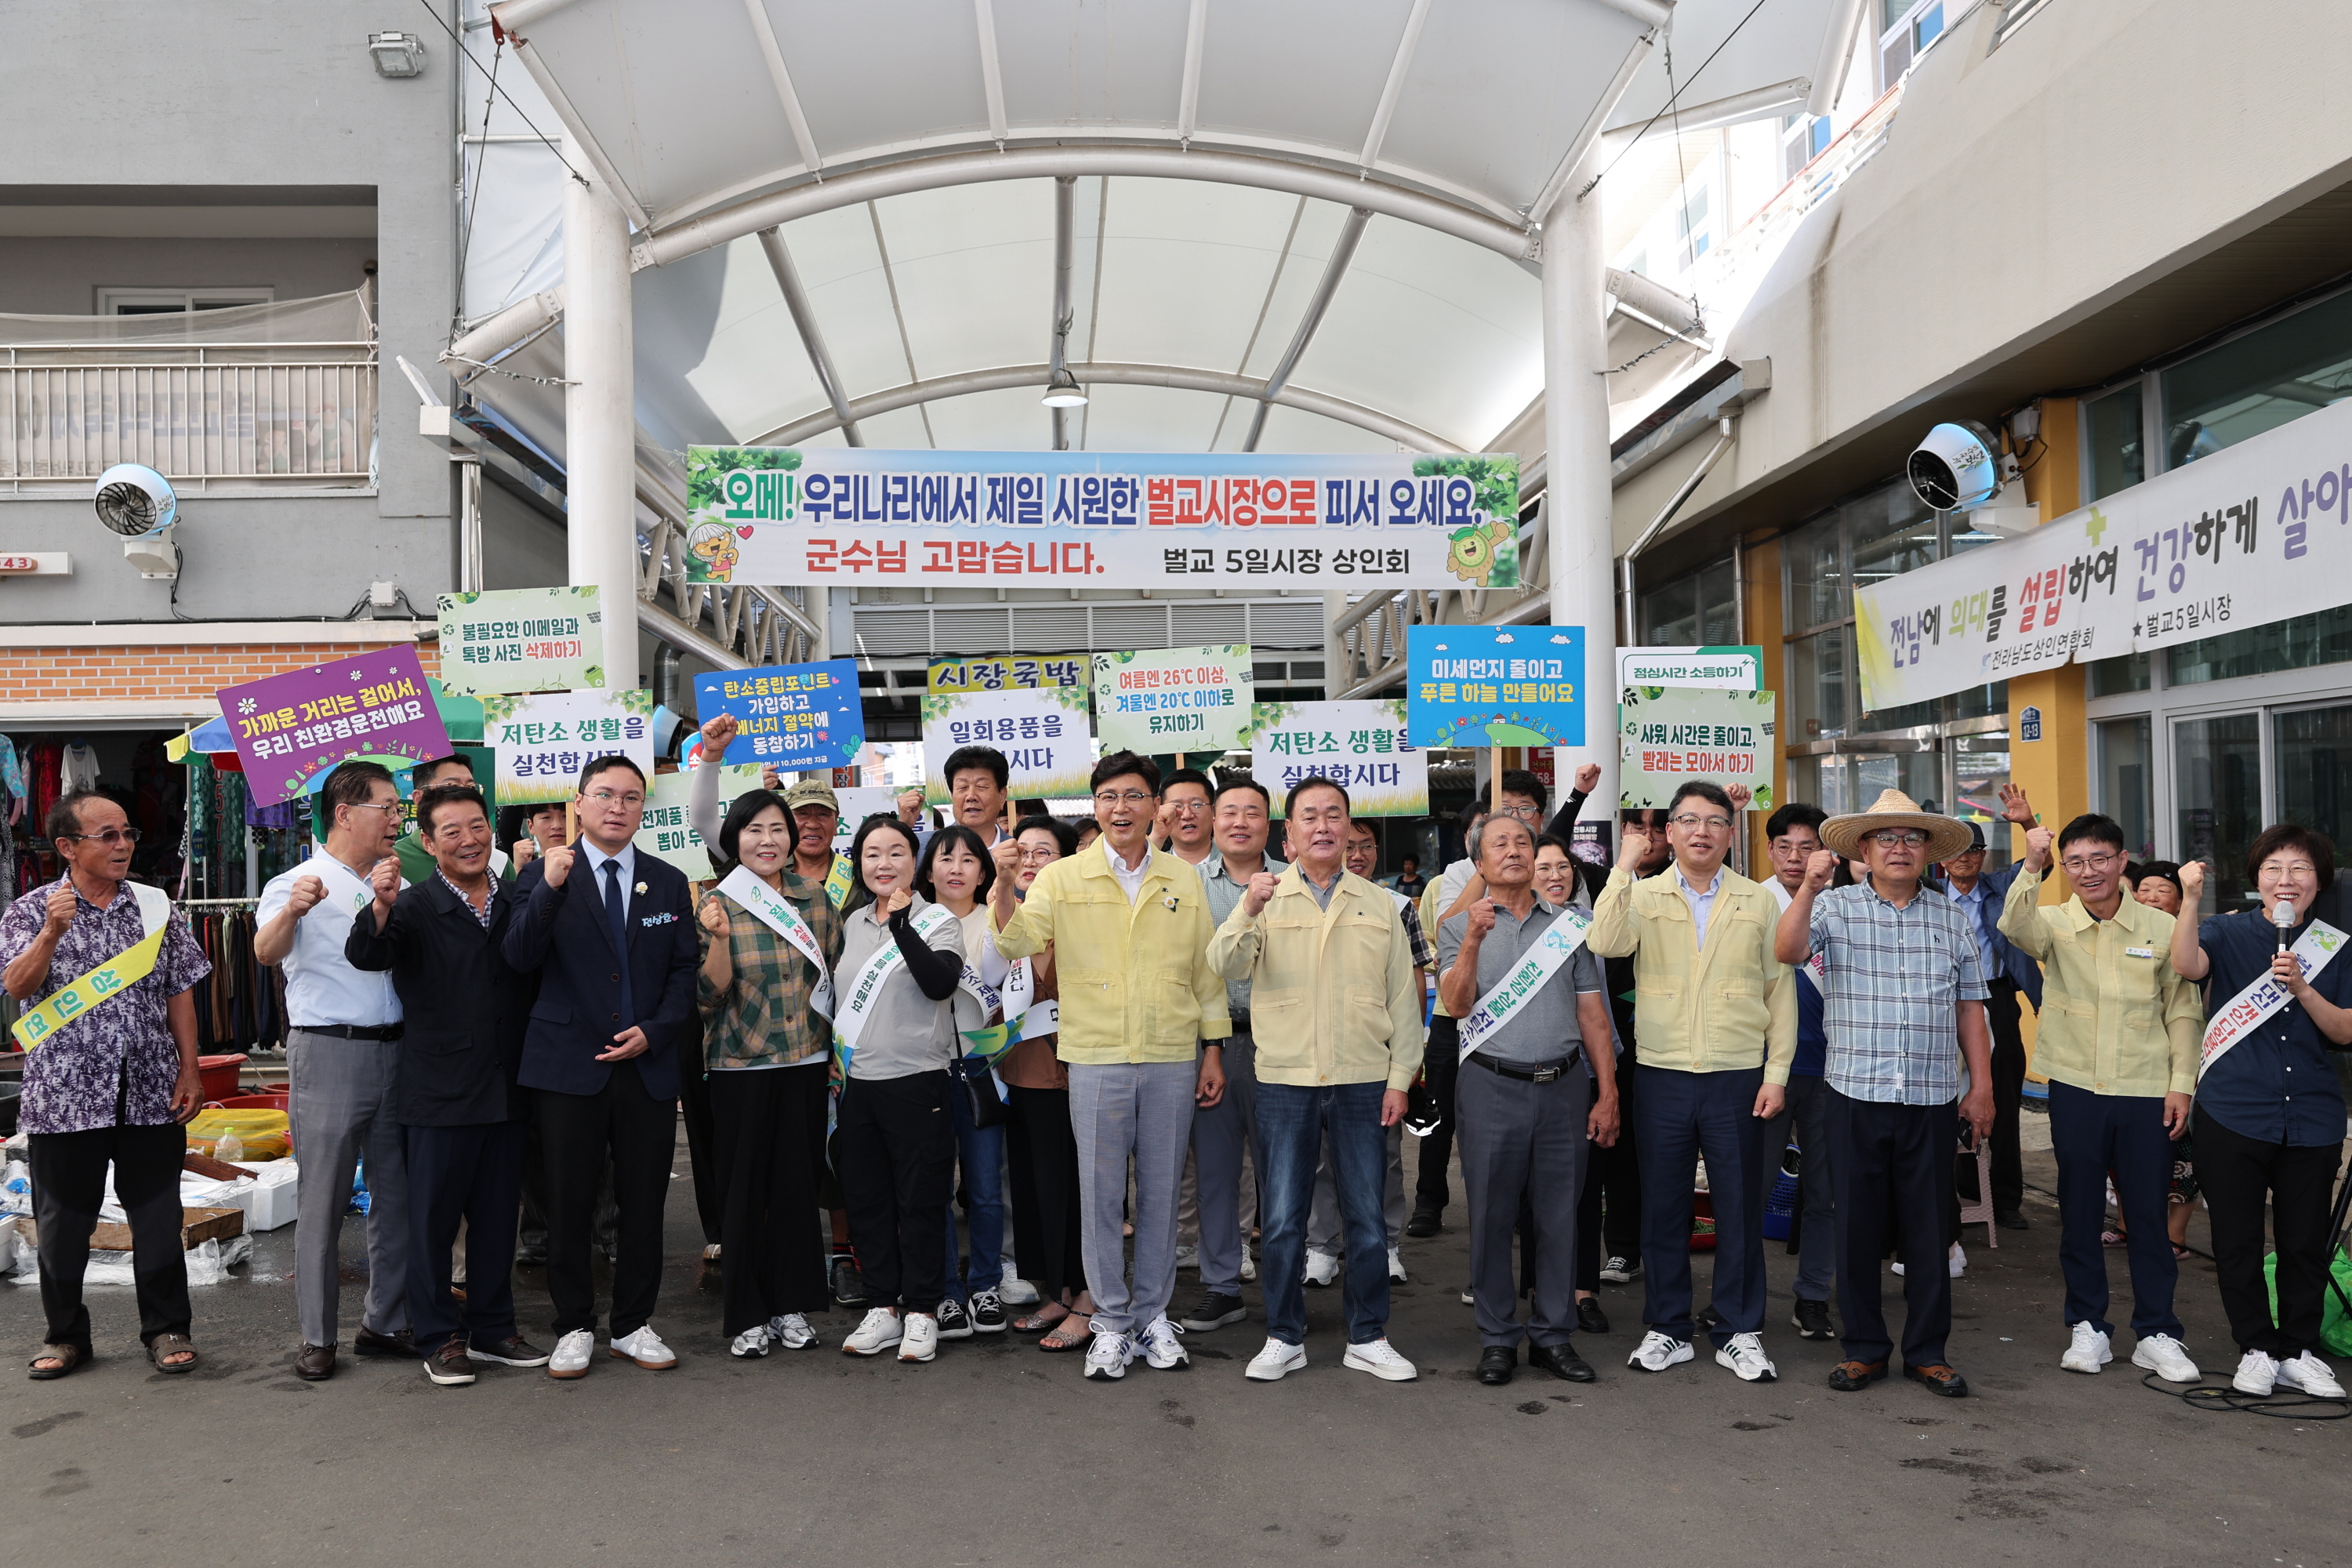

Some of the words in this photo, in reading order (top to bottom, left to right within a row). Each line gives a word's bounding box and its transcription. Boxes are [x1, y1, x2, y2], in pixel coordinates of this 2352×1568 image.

[725, 474, 794, 521] 오메!
[803, 474, 977, 523] 우리나라에서
[986, 476, 1044, 524] 제일
[1052, 477, 1139, 525] 시원한
[1147, 478, 1317, 526] 벌교시장으로
[1326, 479, 1380, 526] 피서
[1388, 479, 1482, 526] 오세요.
[806, 539, 907, 573] 군수님
[921, 540, 1105, 575] 고맙습니다.
[1163, 548, 1214, 574] 벌교
[1225, 548, 1323, 574] 5일시장
[1332, 548, 1410, 574] 상인회
[1890, 604, 1941, 668] 전남에
[1949, 585, 2007, 642] 의대를
[2020, 546, 2118, 634] 설립하여
[2135, 495, 2258, 602] 건강하게
[463, 620, 519, 641] 불필요한
[523, 616, 579, 637] 이메일과
[463, 644, 491, 664] 톡방
[494, 643, 522, 662] 사진
[525, 640, 583, 661] 삭제하기
[1991, 626, 2095, 671] 전라남도상인연합회
[936, 661, 1081, 689] 시장국밥
[1120, 670, 1160, 690] 여름엔
[1197, 666, 1229, 684] 이상,
[1432, 659, 1504, 680] 미세먼지
[1510, 659, 1563, 679] 줄이고
[1634, 666, 1688, 679] 점심시간
[1690, 666, 1743, 678] 소등하기
[724, 673, 831, 698] 탄소중립포인트
[1420, 683, 1456, 704] 푸른
[1461, 683, 1497, 704] 하늘
[1502, 682, 1574, 703] 만들어요
[238, 706, 299, 739] 가까운
[303, 692, 356, 725] 거리는
[358, 677, 423, 709] 걸어서,
[749, 695, 811, 714] 가입하고
[1116, 693, 1157, 713] 겨울엔
[1194, 688, 1235, 708] 이하로
[252, 734, 292, 760] 우리
[295, 700, 426, 749] 친환경운전해요
[502, 721, 569, 745] 저탄소
[576, 717, 644, 742] 생활을
[735, 717, 779, 736] 에너지
[782, 711, 829, 731] 절약에
[950, 714, 1063, 744] 일회용품을
[1149, 713, 1204, 734] 유지하기
[1640, 724, 1668, 746] 샤워
[1670, 724, 1711, 746] 시간은
[1714, 726, 1757, 749] 줄이고,
[753, 733, 814, 755] 동참하기
[1269, 731, 1340, 755] 저탄소
[1348, 728, 1417, 753] 생활을
[781, 757, 812, 767] 10,000원
[815, 755, 828, 764] 지급
[1642, 751, 1682, 772] 빨래는
[1686, 752, 1725, 773] 모아서
[1729, 753, 1755, 774] 하기
[1282, 763, 1400, 789] 실천합시다
[637, 806, 683, 829] 전제품
[658, 830, 685, 852] 뽑아
[959, 964, 982, 986] 탄소
[975, 984, 1000, 1008] 제품
[1510, 959, 1544, 997] 친환경
[23, 969, 122, 1040] 상인연
[851, 969, 879, 1014] 실천해요
[1486, 991, 1517, 1018] 상품
[2250, 982, 2281, 1011] 대신
[1464, 1007, 1495, 1042] 저탄소
[2229, 1000, 2259, 1028] 개인
